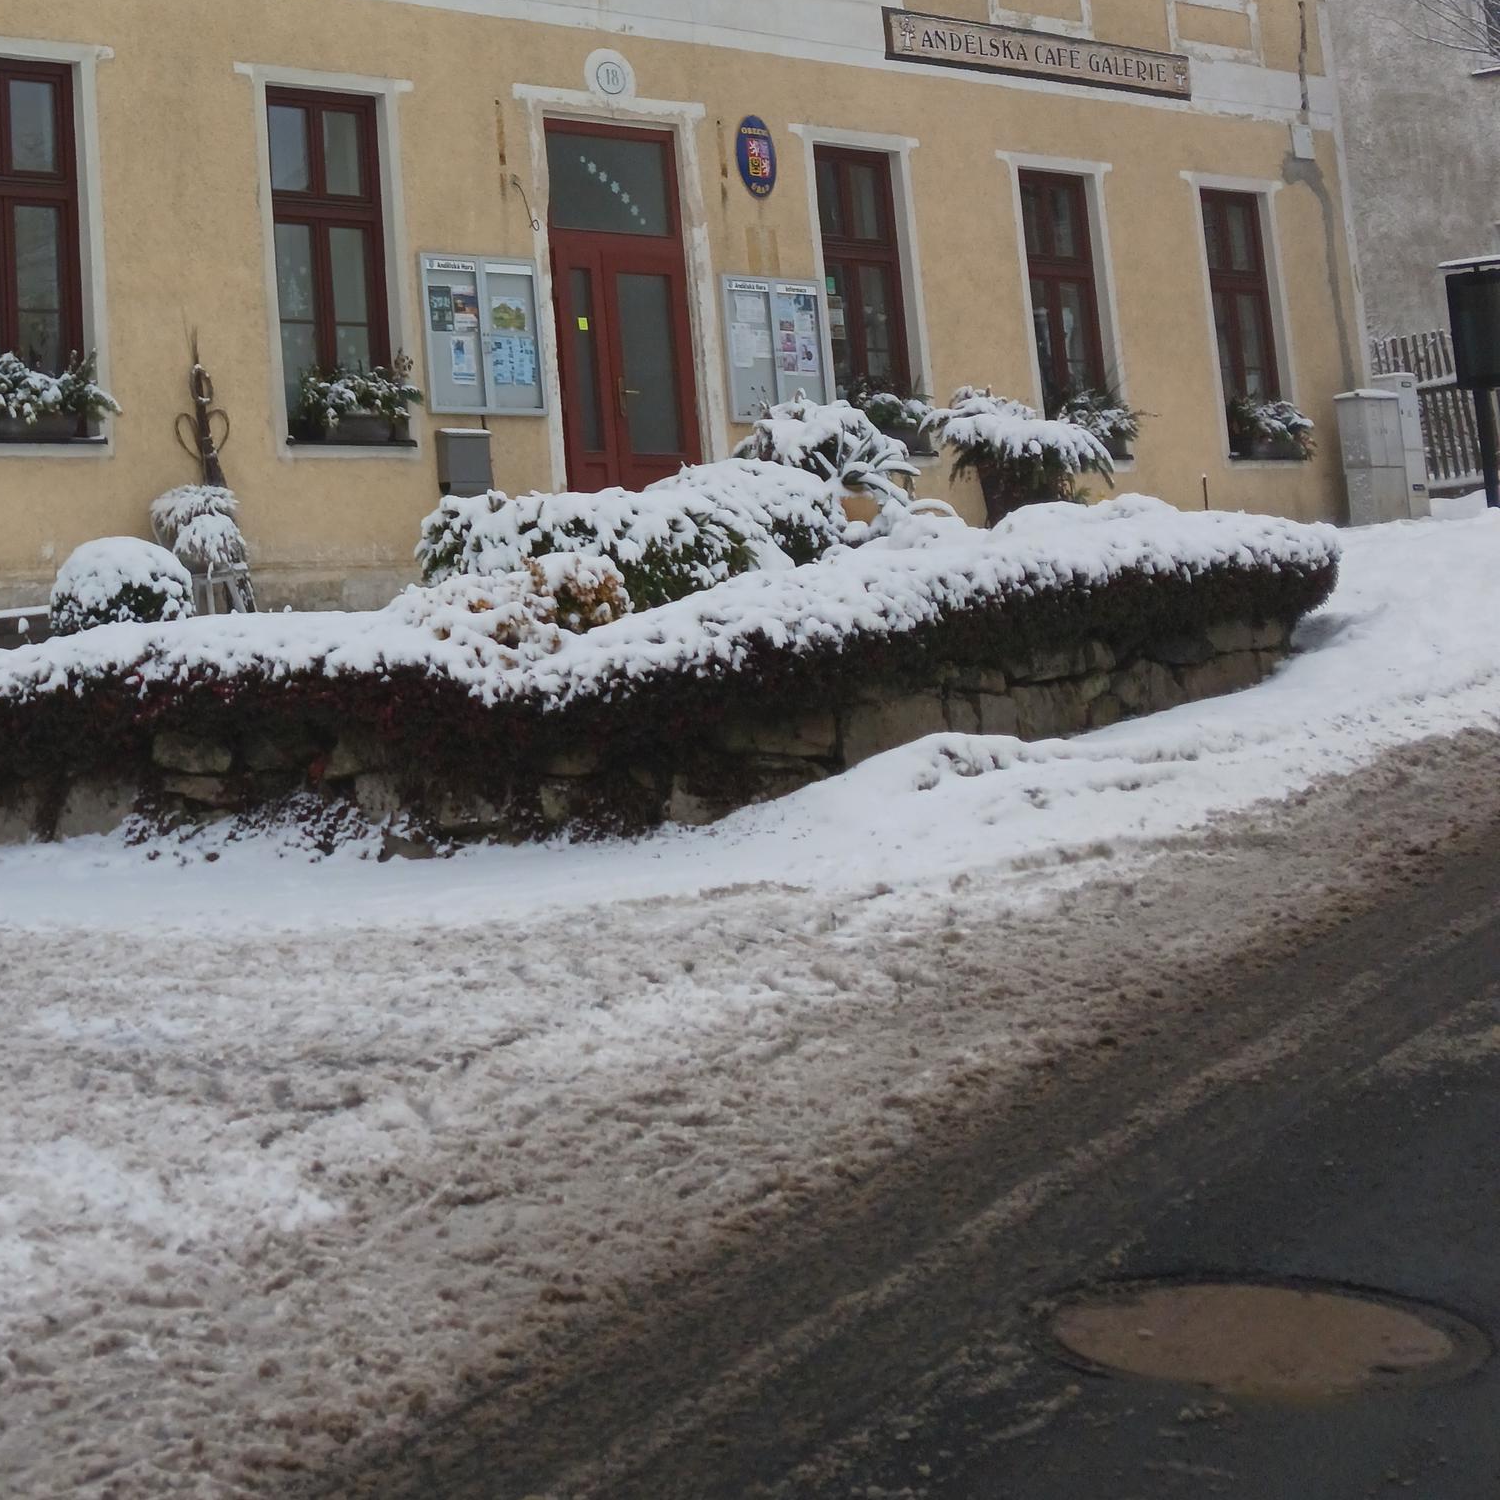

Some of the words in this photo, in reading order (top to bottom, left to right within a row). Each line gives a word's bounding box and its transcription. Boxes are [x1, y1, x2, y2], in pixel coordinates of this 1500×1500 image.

[605, 68, 620, 86] 18
[1034, 44, 1081, 70] CAFÉ
[1088, 53, 1167, 83] GALERIE
